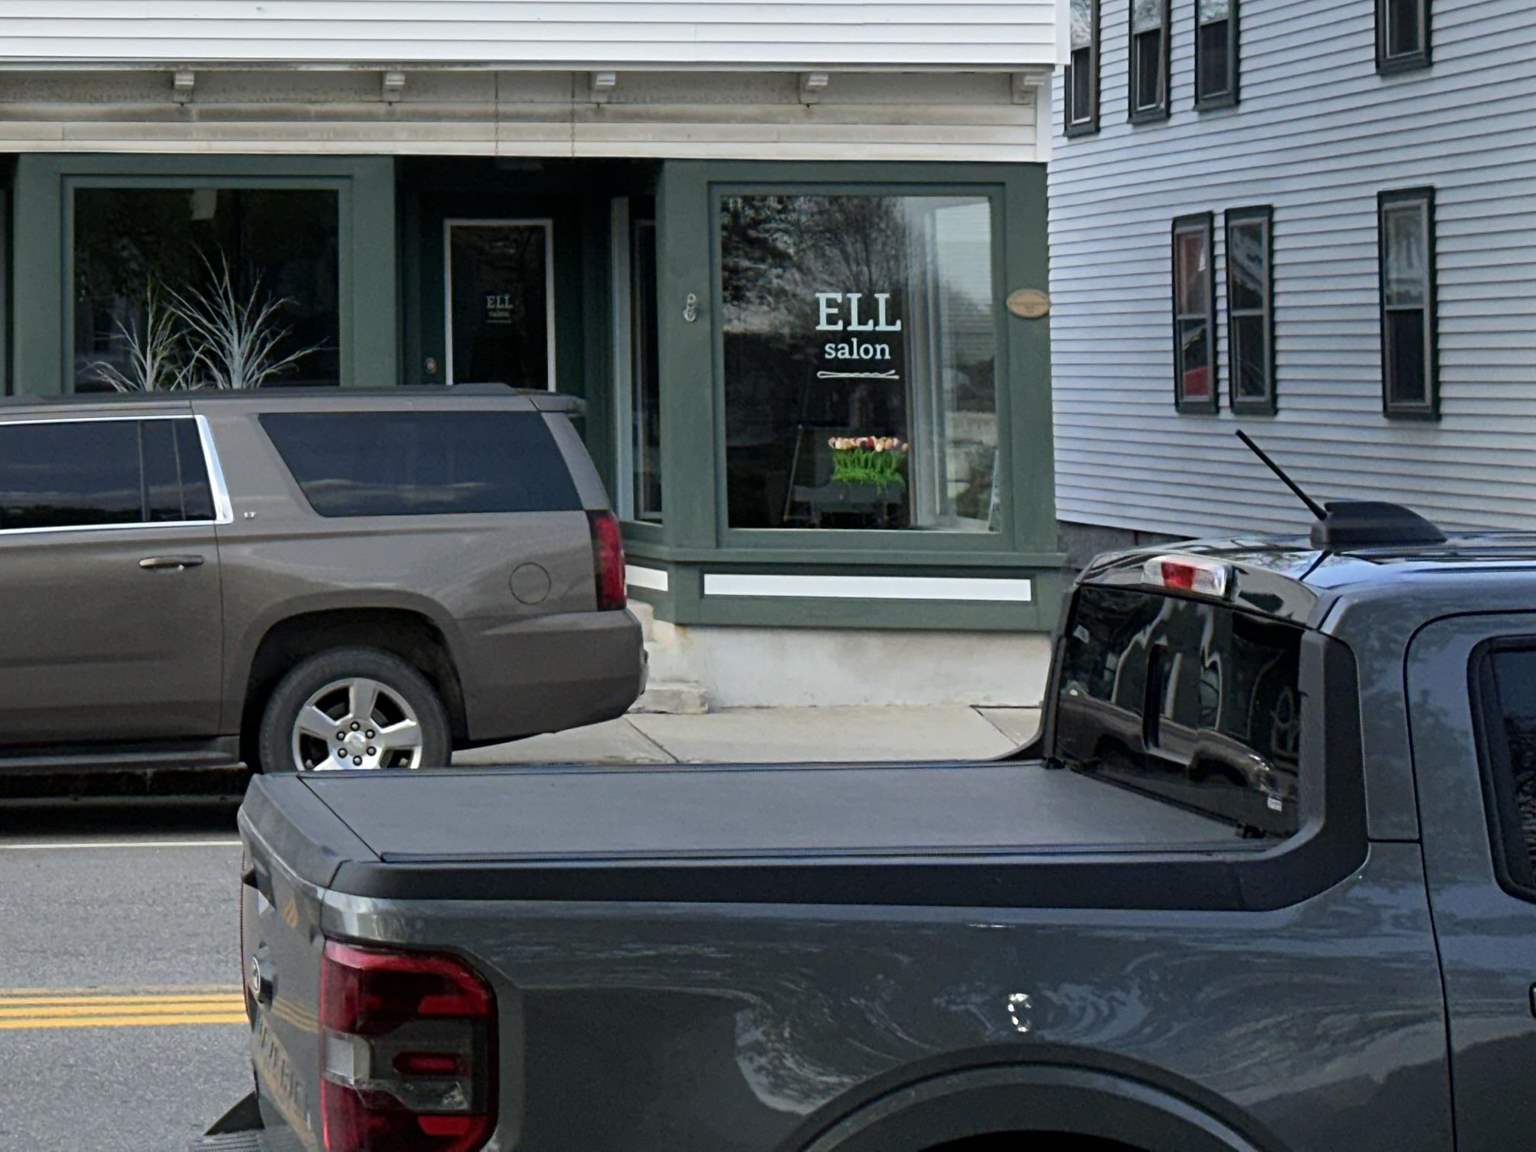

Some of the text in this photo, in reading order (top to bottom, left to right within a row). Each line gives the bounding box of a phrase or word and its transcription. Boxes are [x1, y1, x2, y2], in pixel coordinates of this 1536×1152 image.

[486, 295, 514, 308] ELL
[815, 292, 902, 331] ELL
[824, 337, 891, 360] salon
